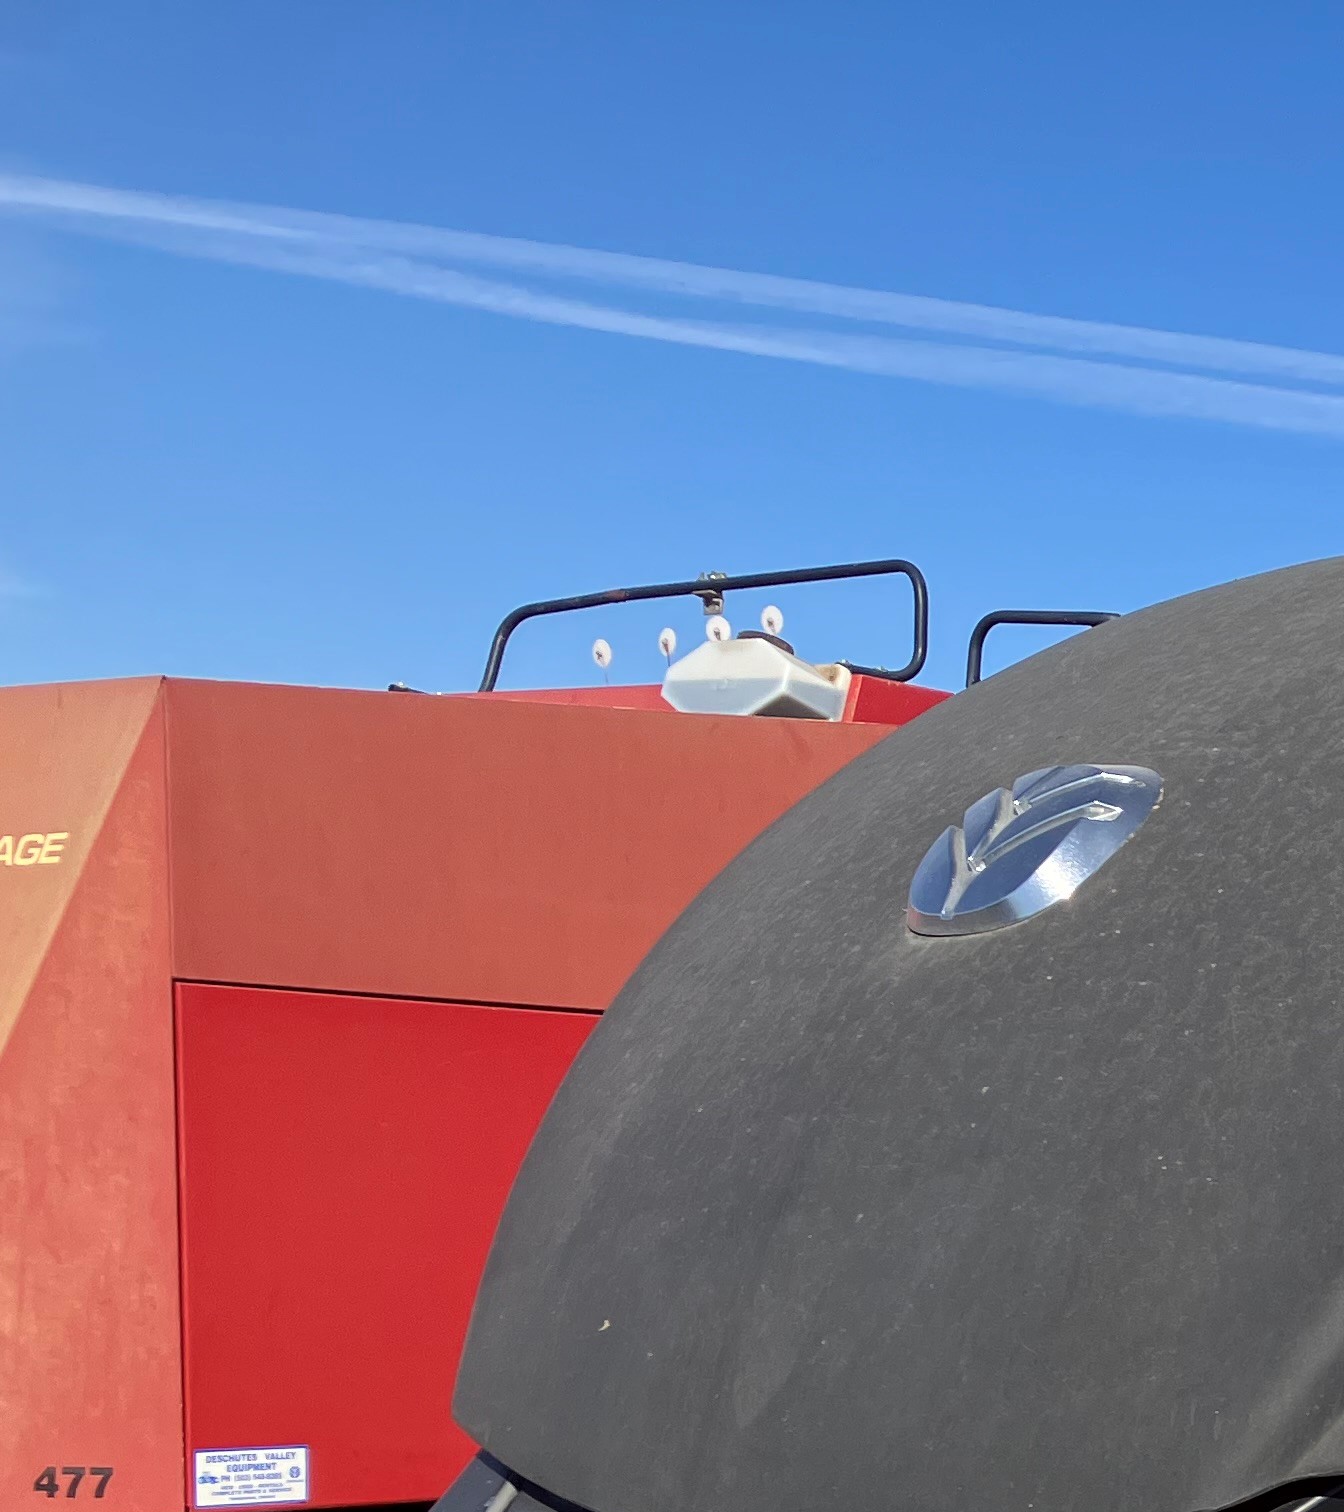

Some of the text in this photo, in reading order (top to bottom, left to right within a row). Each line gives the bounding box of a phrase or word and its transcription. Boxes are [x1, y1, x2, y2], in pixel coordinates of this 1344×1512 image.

[206, 1452, 296, 1463] DESCHUTES VALLEY
[227, 1463, 277, 1472] EQUIPMENT
[33, 1466, 113, 1498] 477
